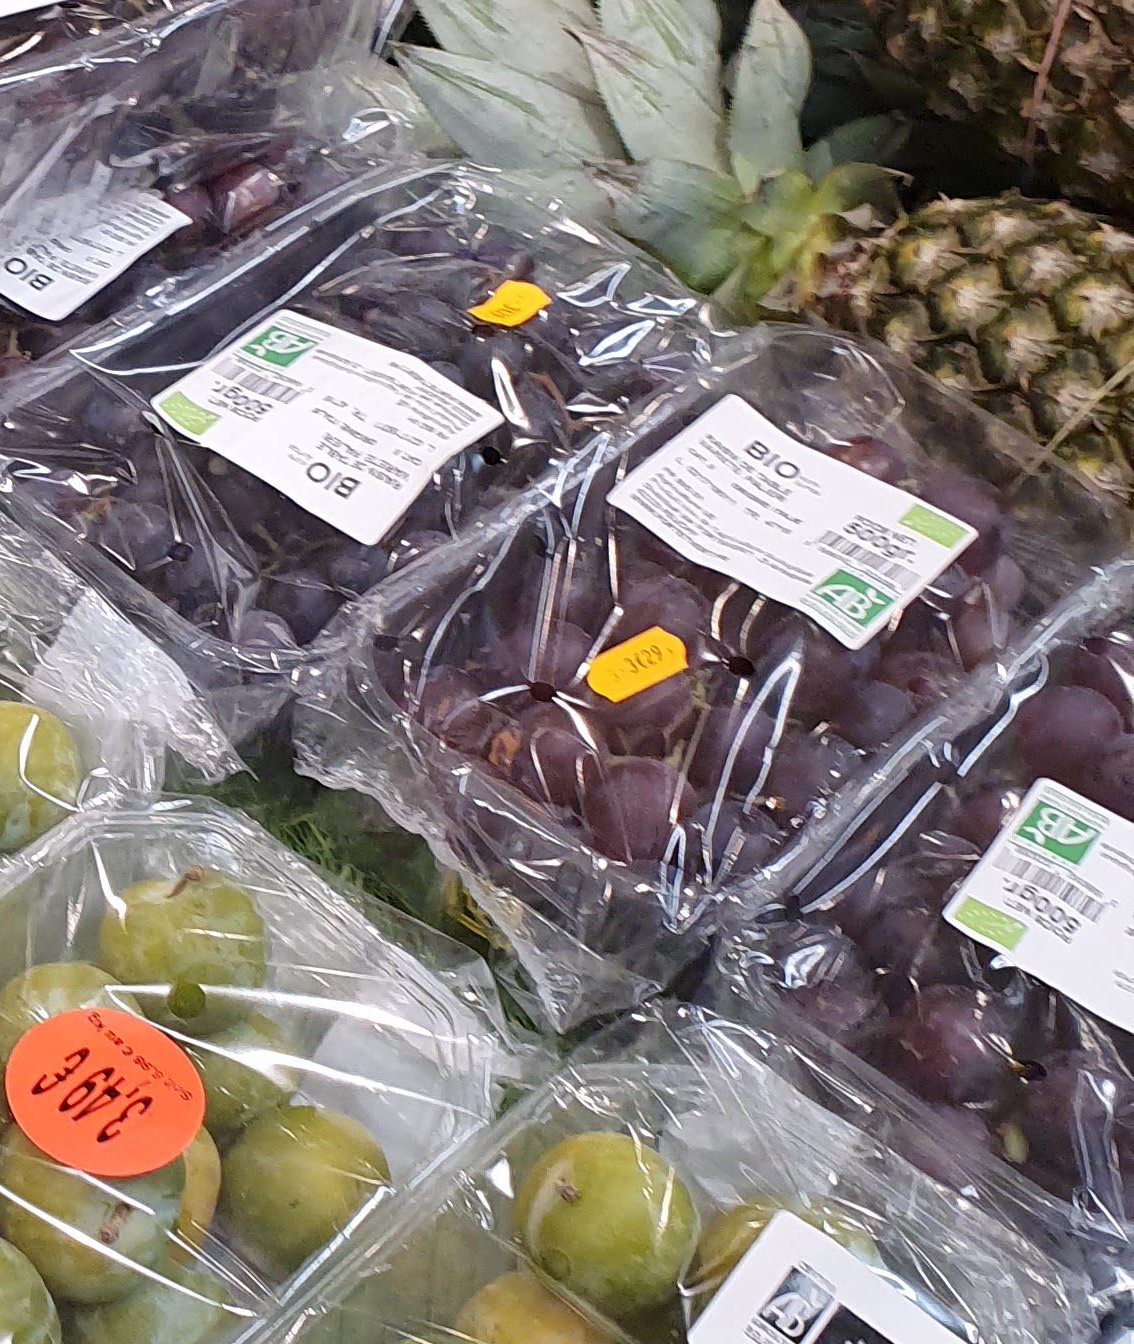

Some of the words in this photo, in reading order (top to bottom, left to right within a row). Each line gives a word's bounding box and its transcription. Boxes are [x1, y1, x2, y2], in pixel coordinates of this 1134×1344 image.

[4, 257, 55, 292] BIO
[303, 459, 359, 499] BIO
[744, 439, 802, 479] BIO
[31, 1047, 90, 1094] €
[58, 1068, 153, 1141] 3,49
